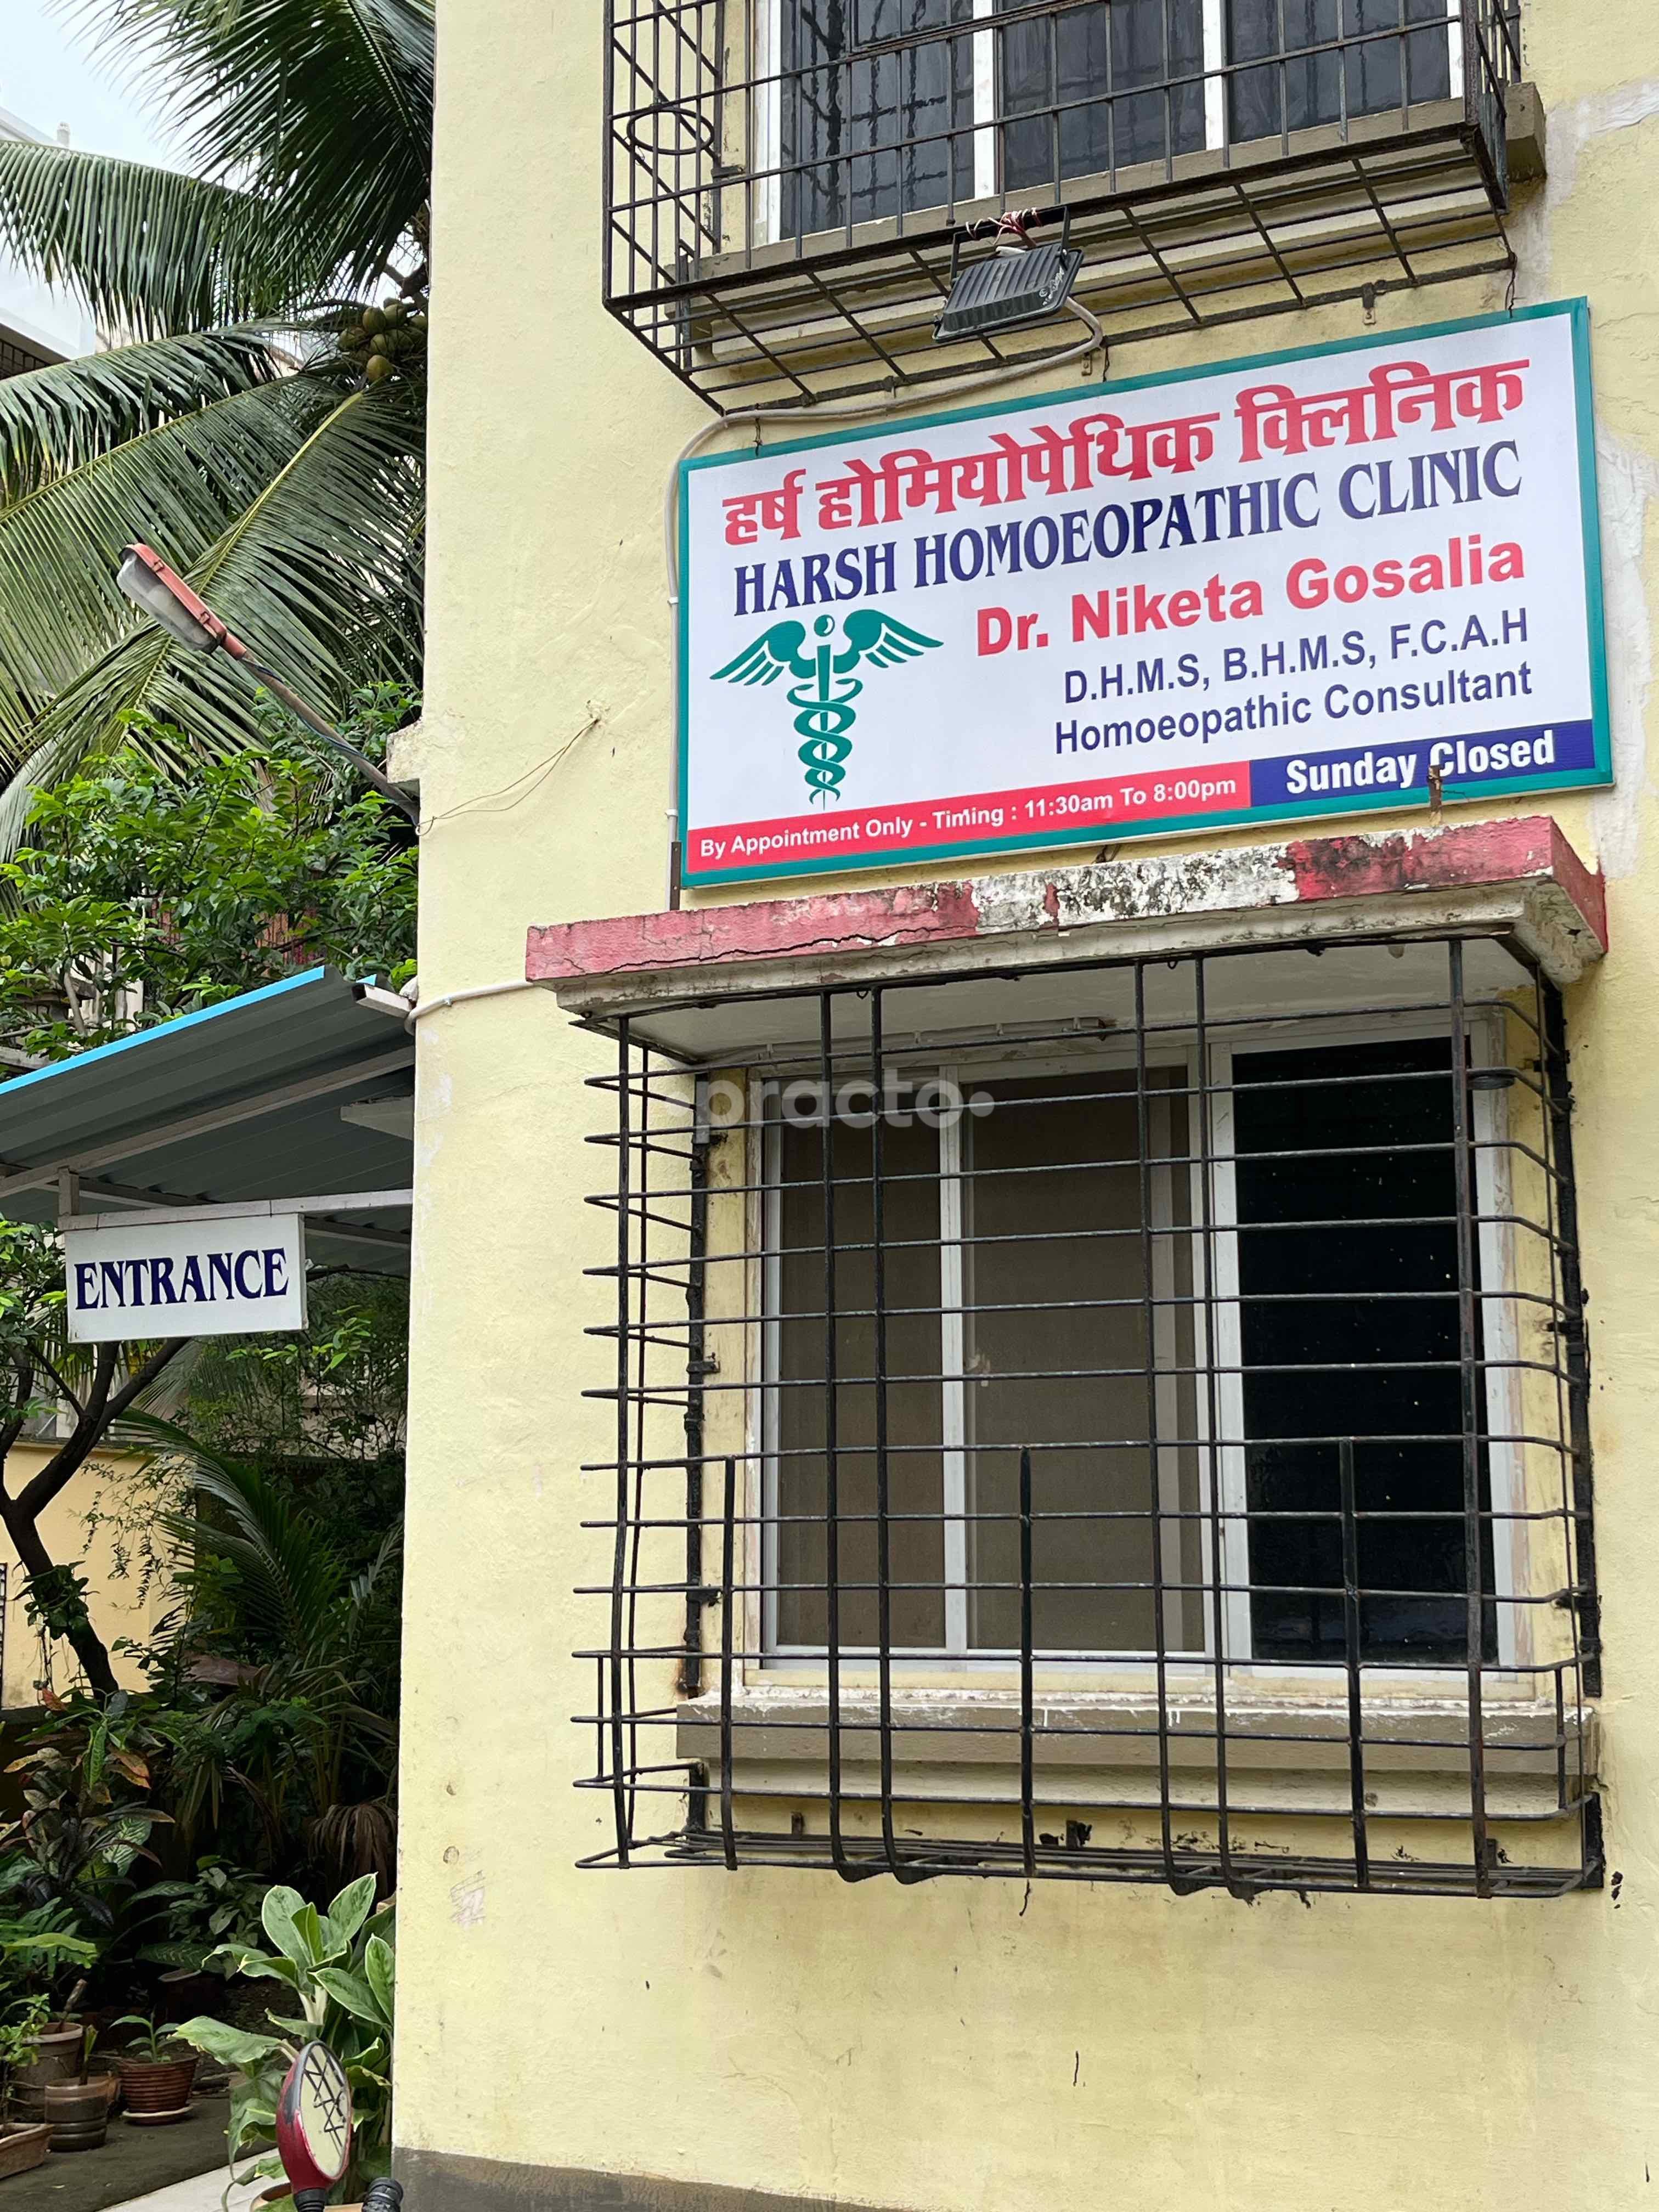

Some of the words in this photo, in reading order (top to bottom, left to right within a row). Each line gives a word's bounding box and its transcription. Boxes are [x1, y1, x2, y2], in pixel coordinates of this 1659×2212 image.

[722, 469, 806, 545] हर्ष
[1235, 360, 1530, 462] क्लिनिक
[734, 541, 897, 616] HARSH
[914, 472, 1321, 588] HOMOEOPATHIC
[1339, 439, 1521, 520] CLINIC
[978, 607, 1048, 656] Dr.
[1072, 573, 1263, 642] Niketa
[1287, 535, 1524, 608] Gosalia
[1065, 654, 1209, 703] D.H.M.S,
[1224, 631, 1375, 681] B.H.M.S,
[1391, 608, 1527, 659] F.C.A.H
[1056, 690, 1312, 753] Homoeopathic
[1325, 660, 1532, 718] Consultant
[1286, 751, 1418, 794] Sunday
[1429, 729, 1555, 778] Closed
[701, 839, 727, 860] By
[730, 822, 860, 856] Appointment
[865, 816, 913, 838] Only
[932, 808, 1004, 830] Timing
[1024, 794, 1113, 818] 11:30am
[1120, 787, 1147, 806] To
[1153, 779, 1237, 803] 8:00pm
[74, 1248, 288, 1310] ENTRANCE
